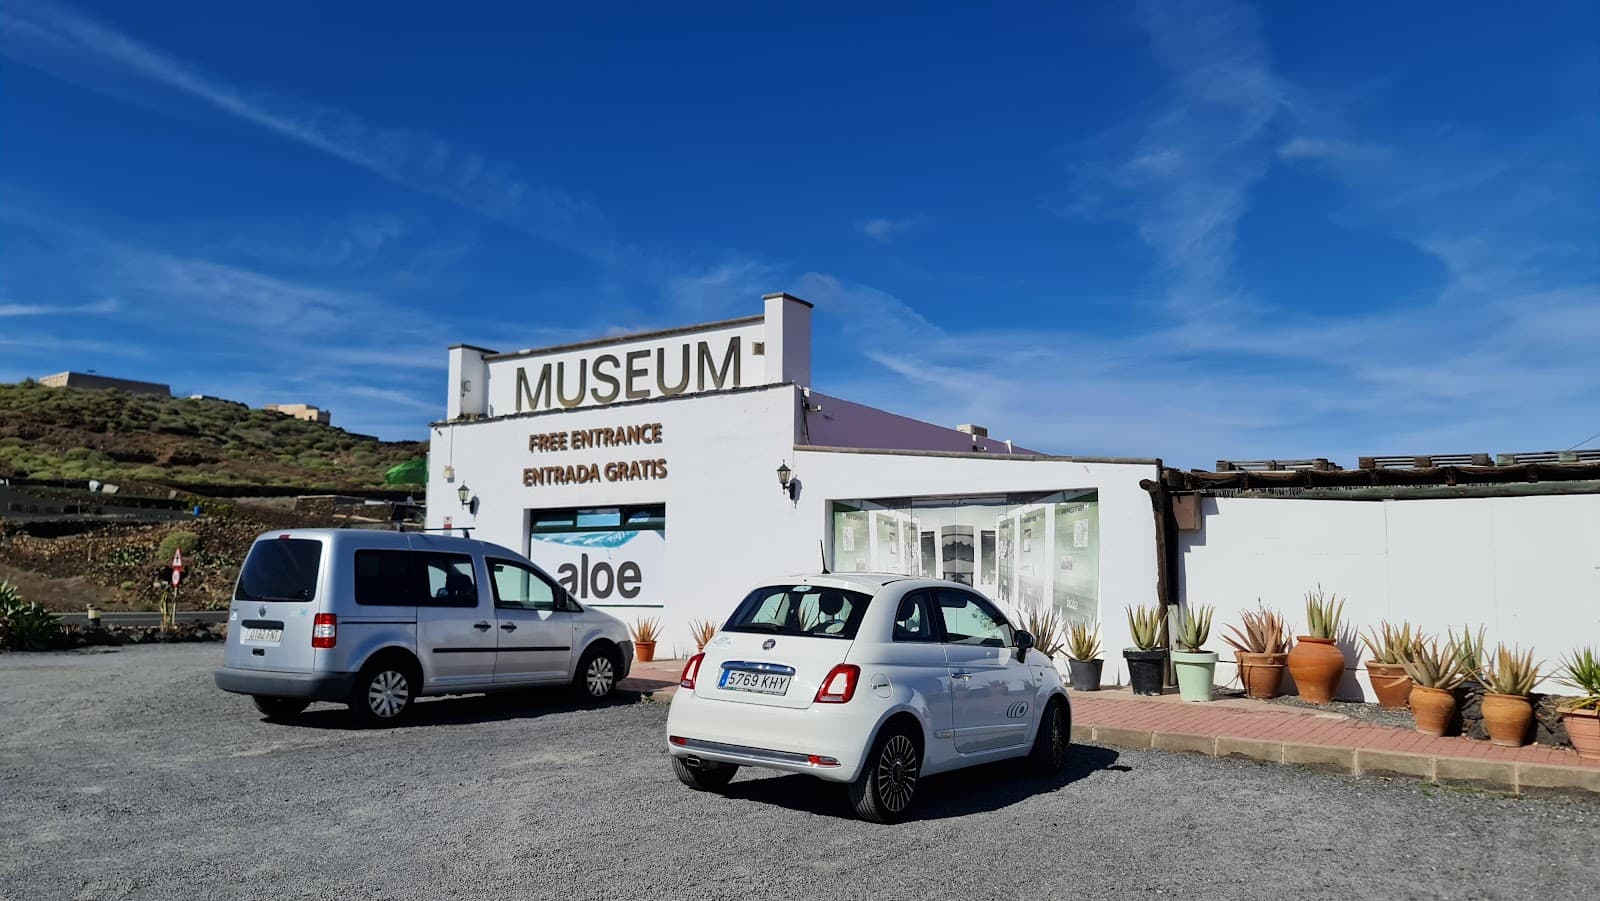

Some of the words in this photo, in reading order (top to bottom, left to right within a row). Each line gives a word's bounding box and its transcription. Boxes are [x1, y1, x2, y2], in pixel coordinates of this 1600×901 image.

[516, 336, 741, 412] MUSEUM
[529, 431, 568, 453] FREE
[571, 423, 663, 450] ENTRANCE
[523, 463, 601, 487] ENTRADA
[604, 458, 668, 482] GRATIS
[557, 553, 642, 599] aloe
[728, 672, 759, 687] 5769
[761, 675, 787, 690] KHY
